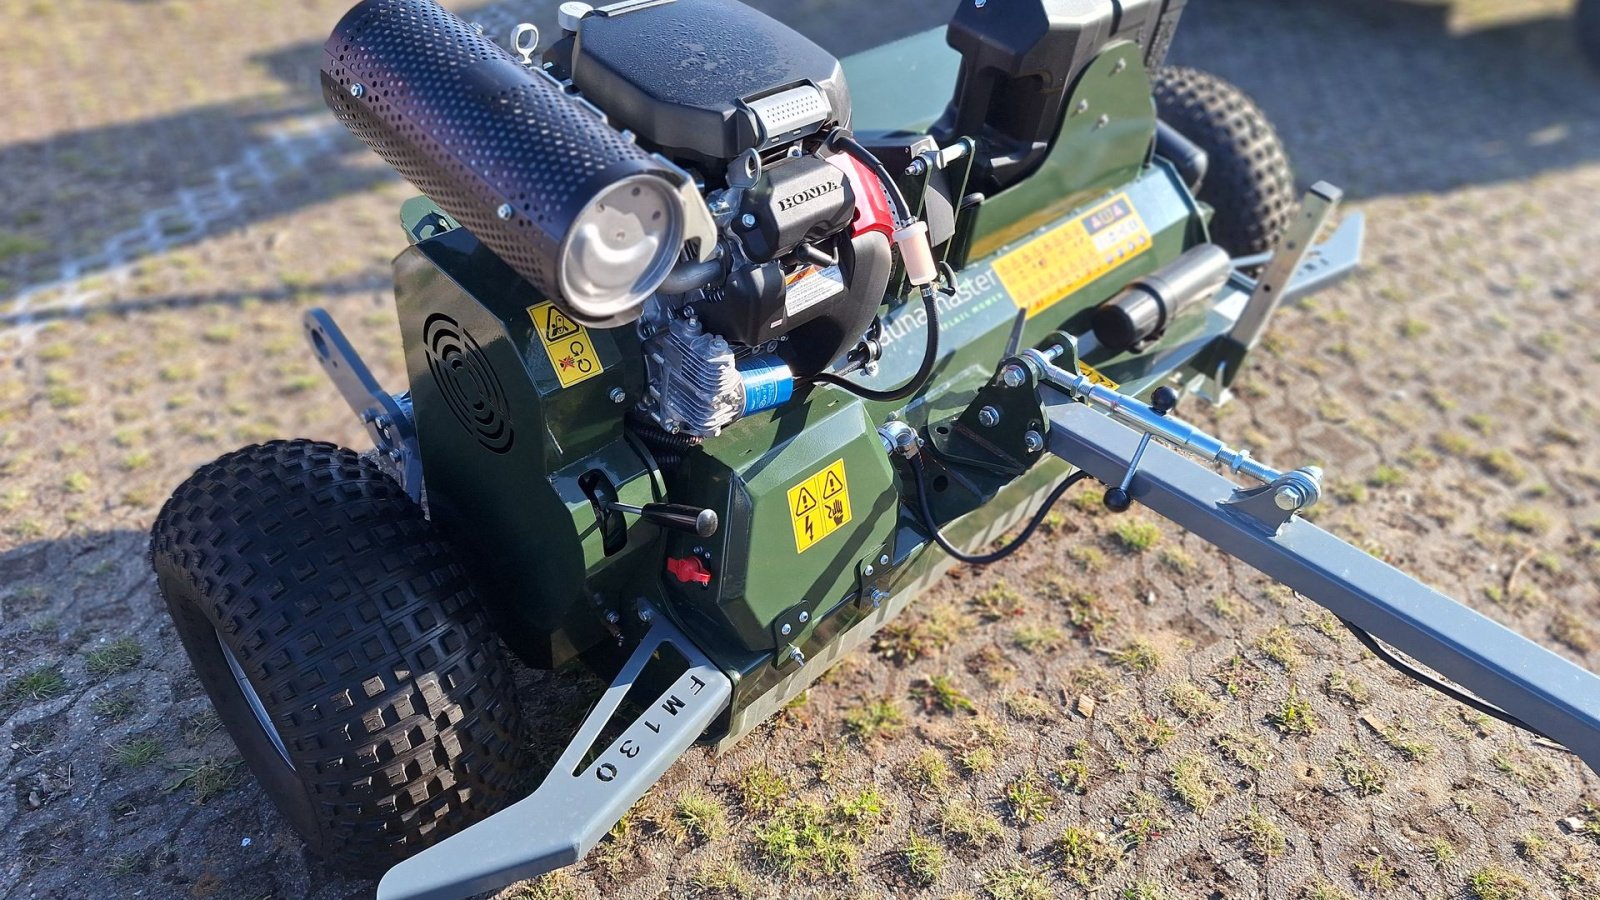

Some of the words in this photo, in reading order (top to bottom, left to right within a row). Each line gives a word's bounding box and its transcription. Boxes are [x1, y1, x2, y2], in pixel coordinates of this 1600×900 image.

[778, 181, 841, 211] HONDA
[878, 268, 997, 347] aunamaster
[596, 675, 706, 782] FM130
